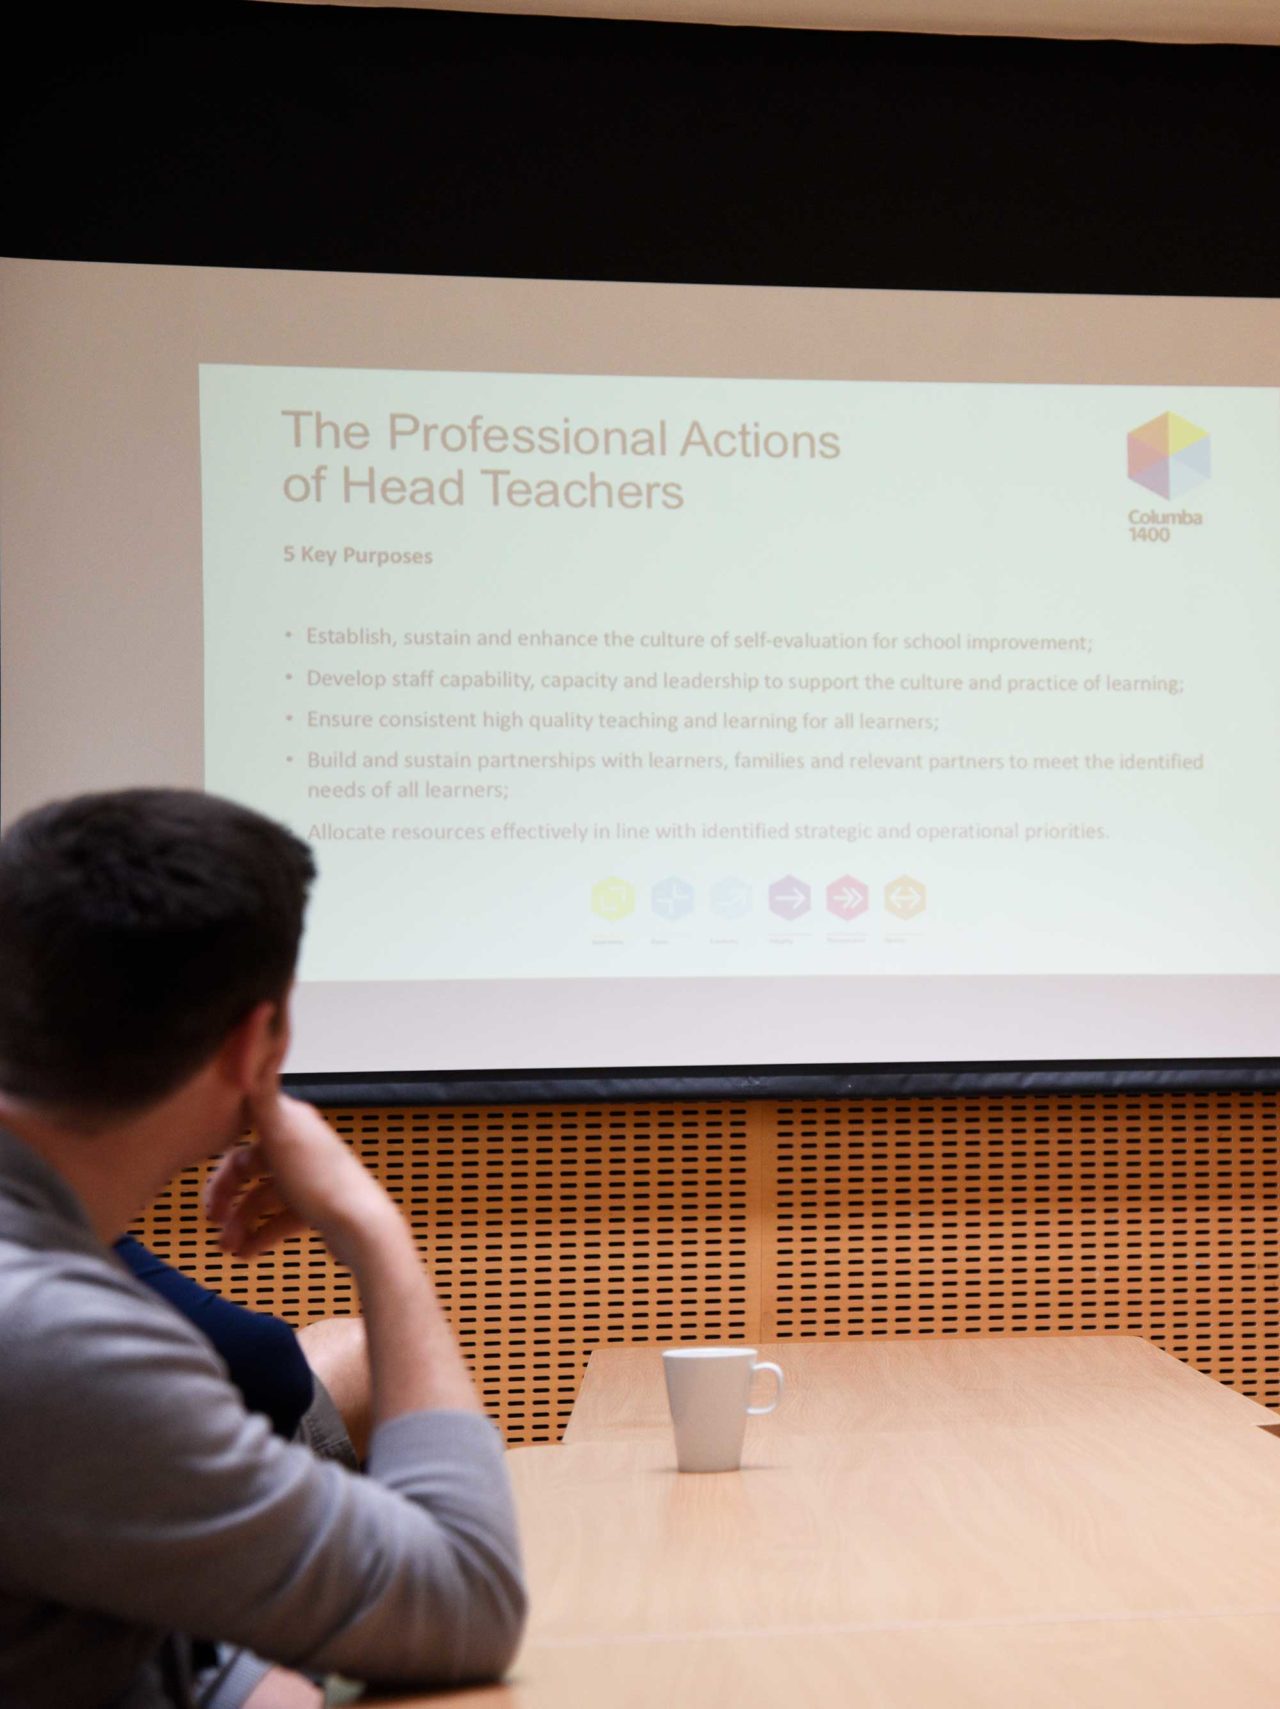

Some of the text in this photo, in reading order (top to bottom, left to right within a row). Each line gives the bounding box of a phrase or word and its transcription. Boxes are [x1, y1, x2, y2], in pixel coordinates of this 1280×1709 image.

[280, 409, 842, 460] The Professional Actions
[282, 464, 685, 510] of Head Teachers
[1127, 508, 1204, 526] Columba
[1128, 526, 1172, 543] 1400
[283, 544, 434, 568] 5 Key Purposes
[306, 626, 1093, 654] Establish, sustain and enhance the culture of self-evaluation for school improvement;
[306, 668, 1184, 696] Develop staff capability, capacity and leadership to support the culture and practice of learning;
[307, 710, 939, 734] Ensure consistent high quality teaching and learning for all learners;
[307, 750, 1205, 773] Build and sustain partnerships with learners, families and relevant partners to meet the identified
[307, 779, 509, 801] needs of all learners;
[306, 821, 1110, 844] Allocate resources effectively in line with identified strategic and operational priorities.
